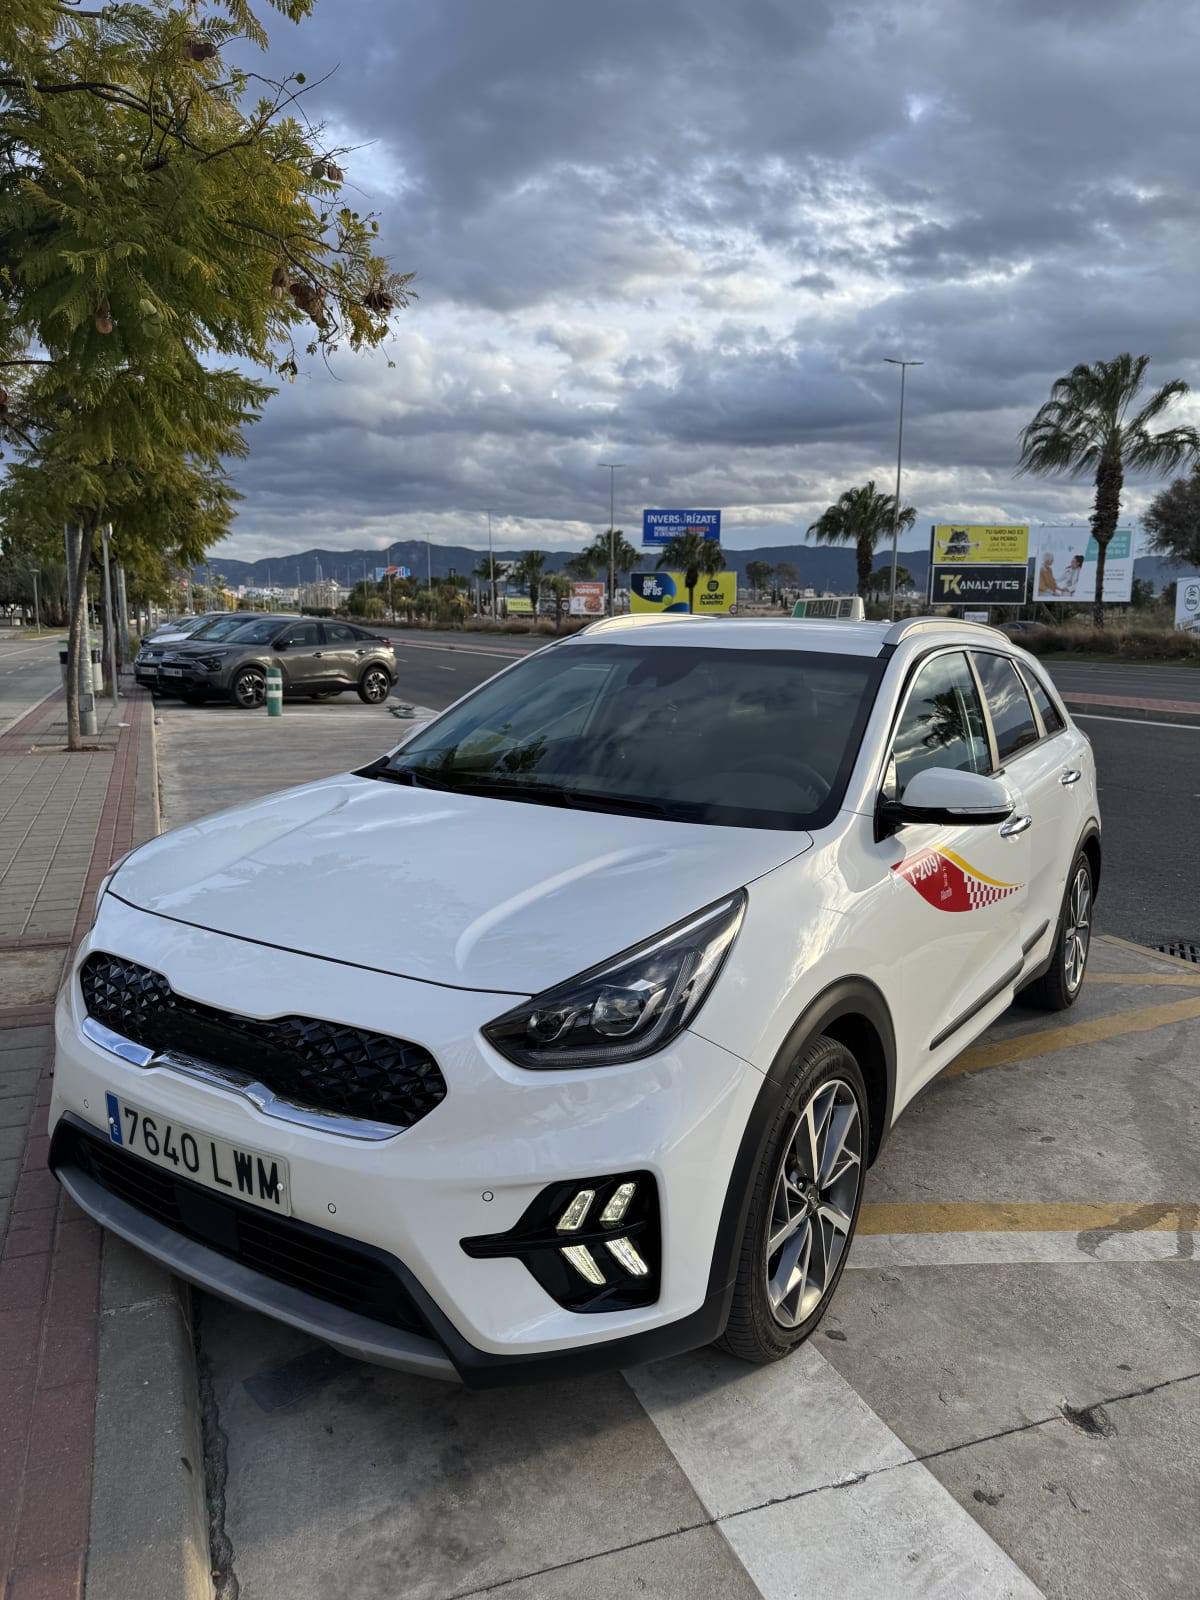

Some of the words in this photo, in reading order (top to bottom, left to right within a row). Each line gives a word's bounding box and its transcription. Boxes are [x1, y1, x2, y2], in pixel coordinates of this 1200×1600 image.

[643, 580, 658, 588] ONE
[643, 587, 651, 596] OF
[652, 587, 663, 596] US
[940, 574, 962, 595] TK
[960, 581, 1019, 590] ANALYTICS
[806, 601, 832, 617] TAXI
[124, 1107, 200, 1173] 7640
[210, 1142, 281, 1205] LWM
